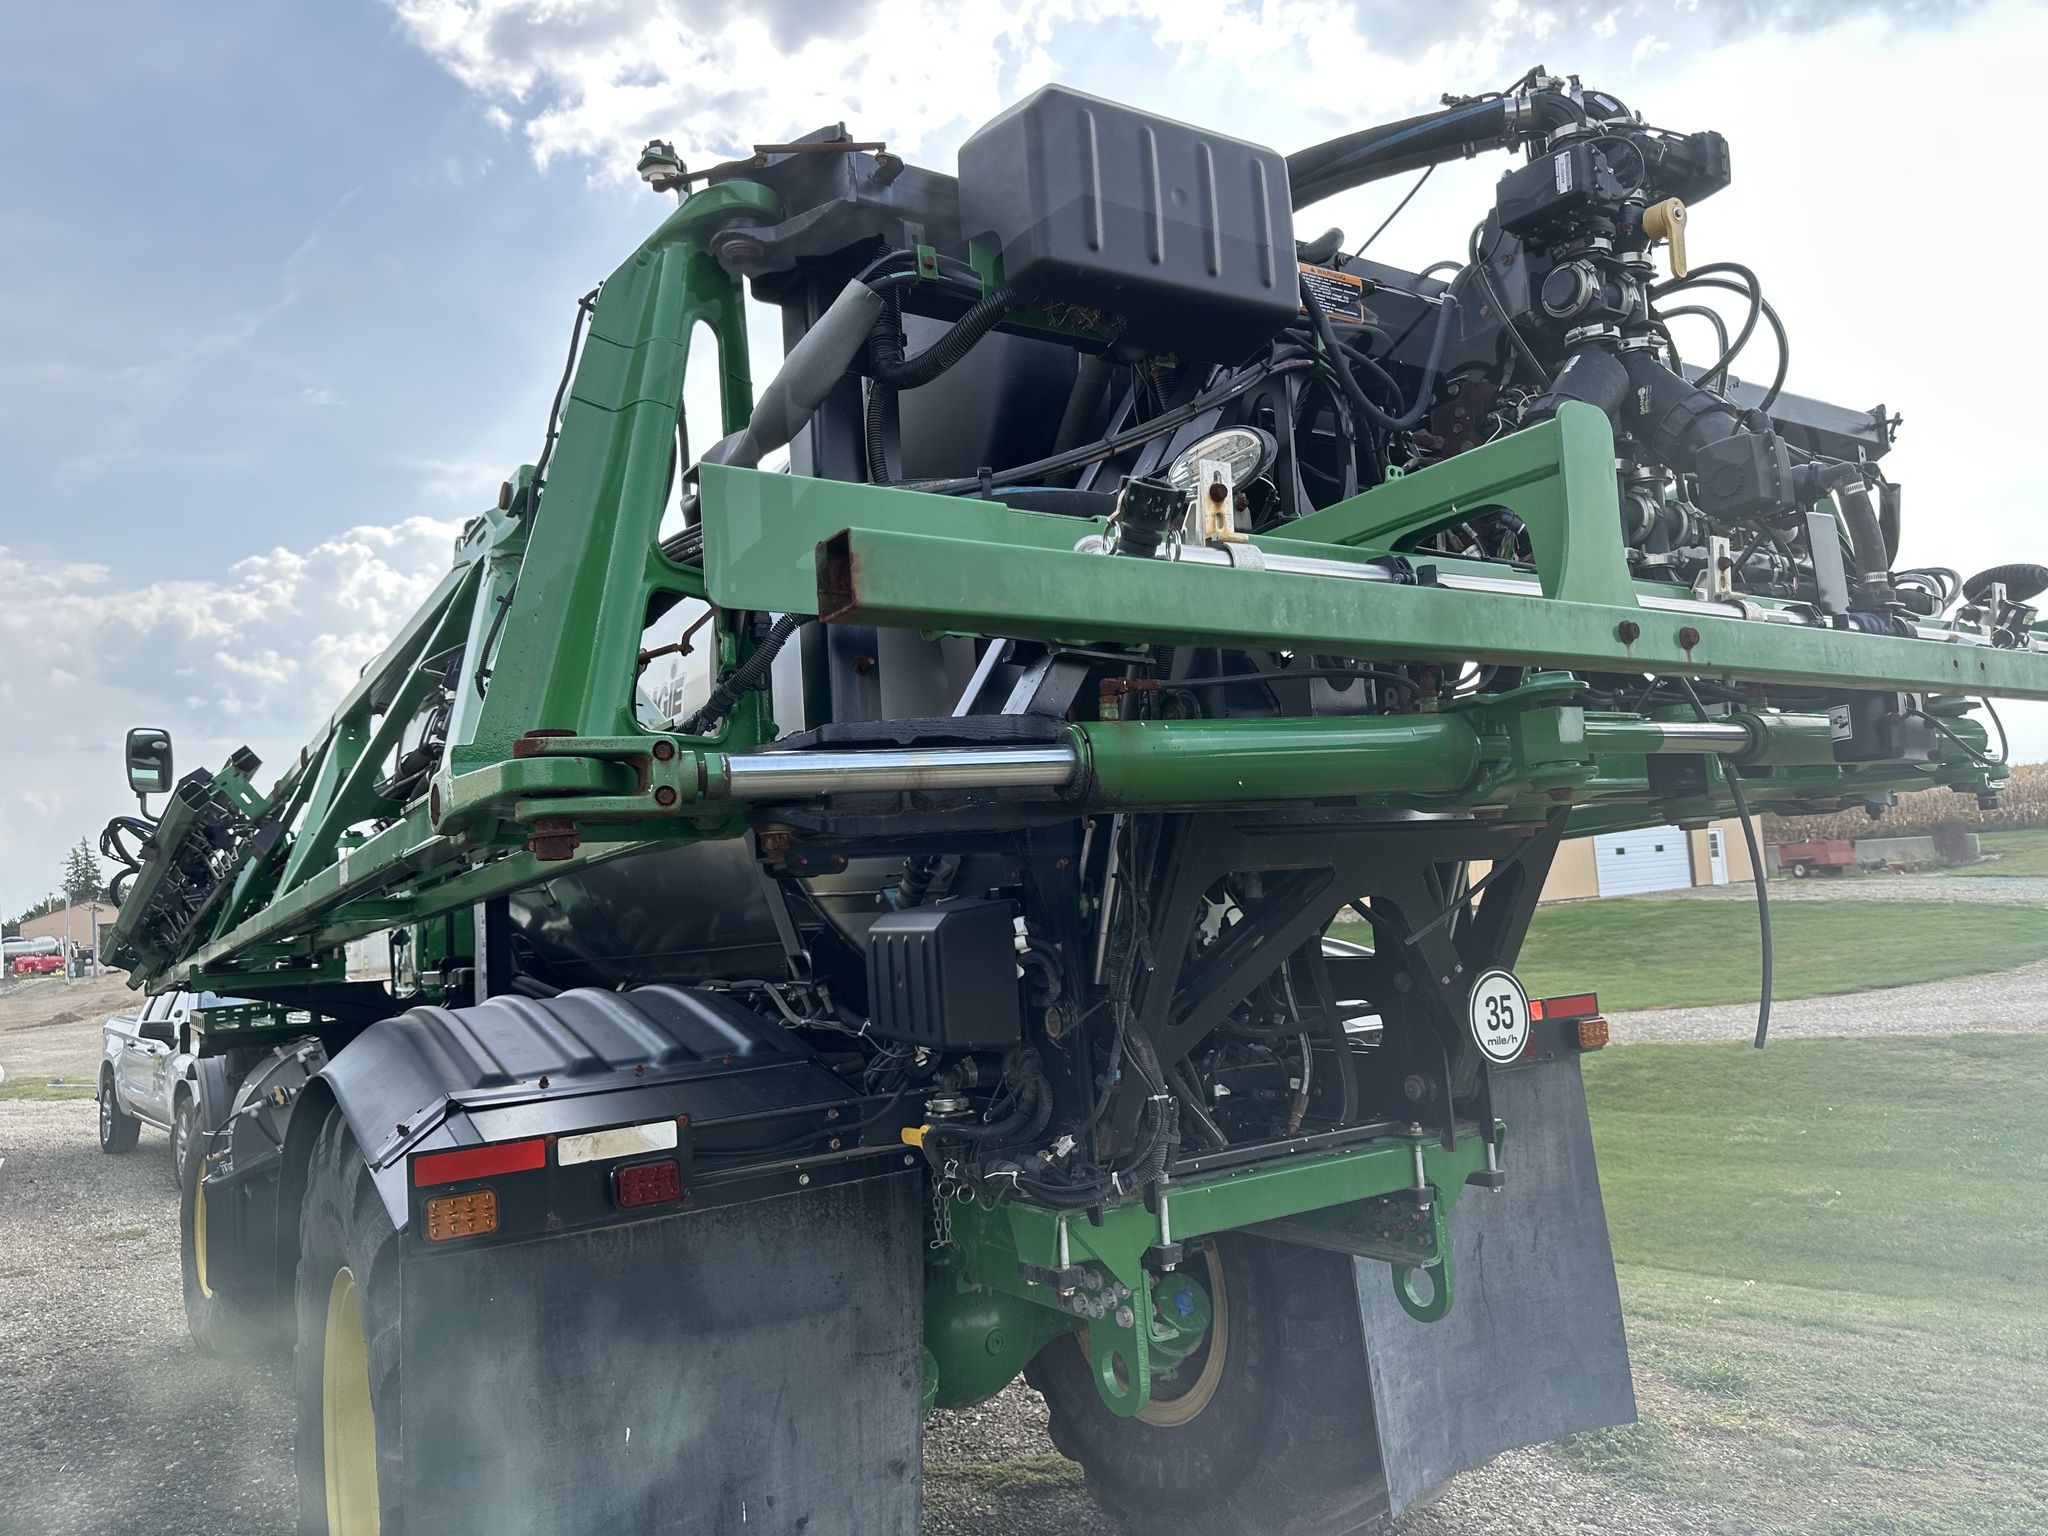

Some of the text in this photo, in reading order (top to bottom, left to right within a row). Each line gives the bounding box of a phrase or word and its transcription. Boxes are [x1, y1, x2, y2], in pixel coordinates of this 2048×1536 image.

[1317, 267, 1346, 281] WARNING
[1485, 994, 1514, 1031] 35
[1487, 1035, 1518, 1047] mile/h
